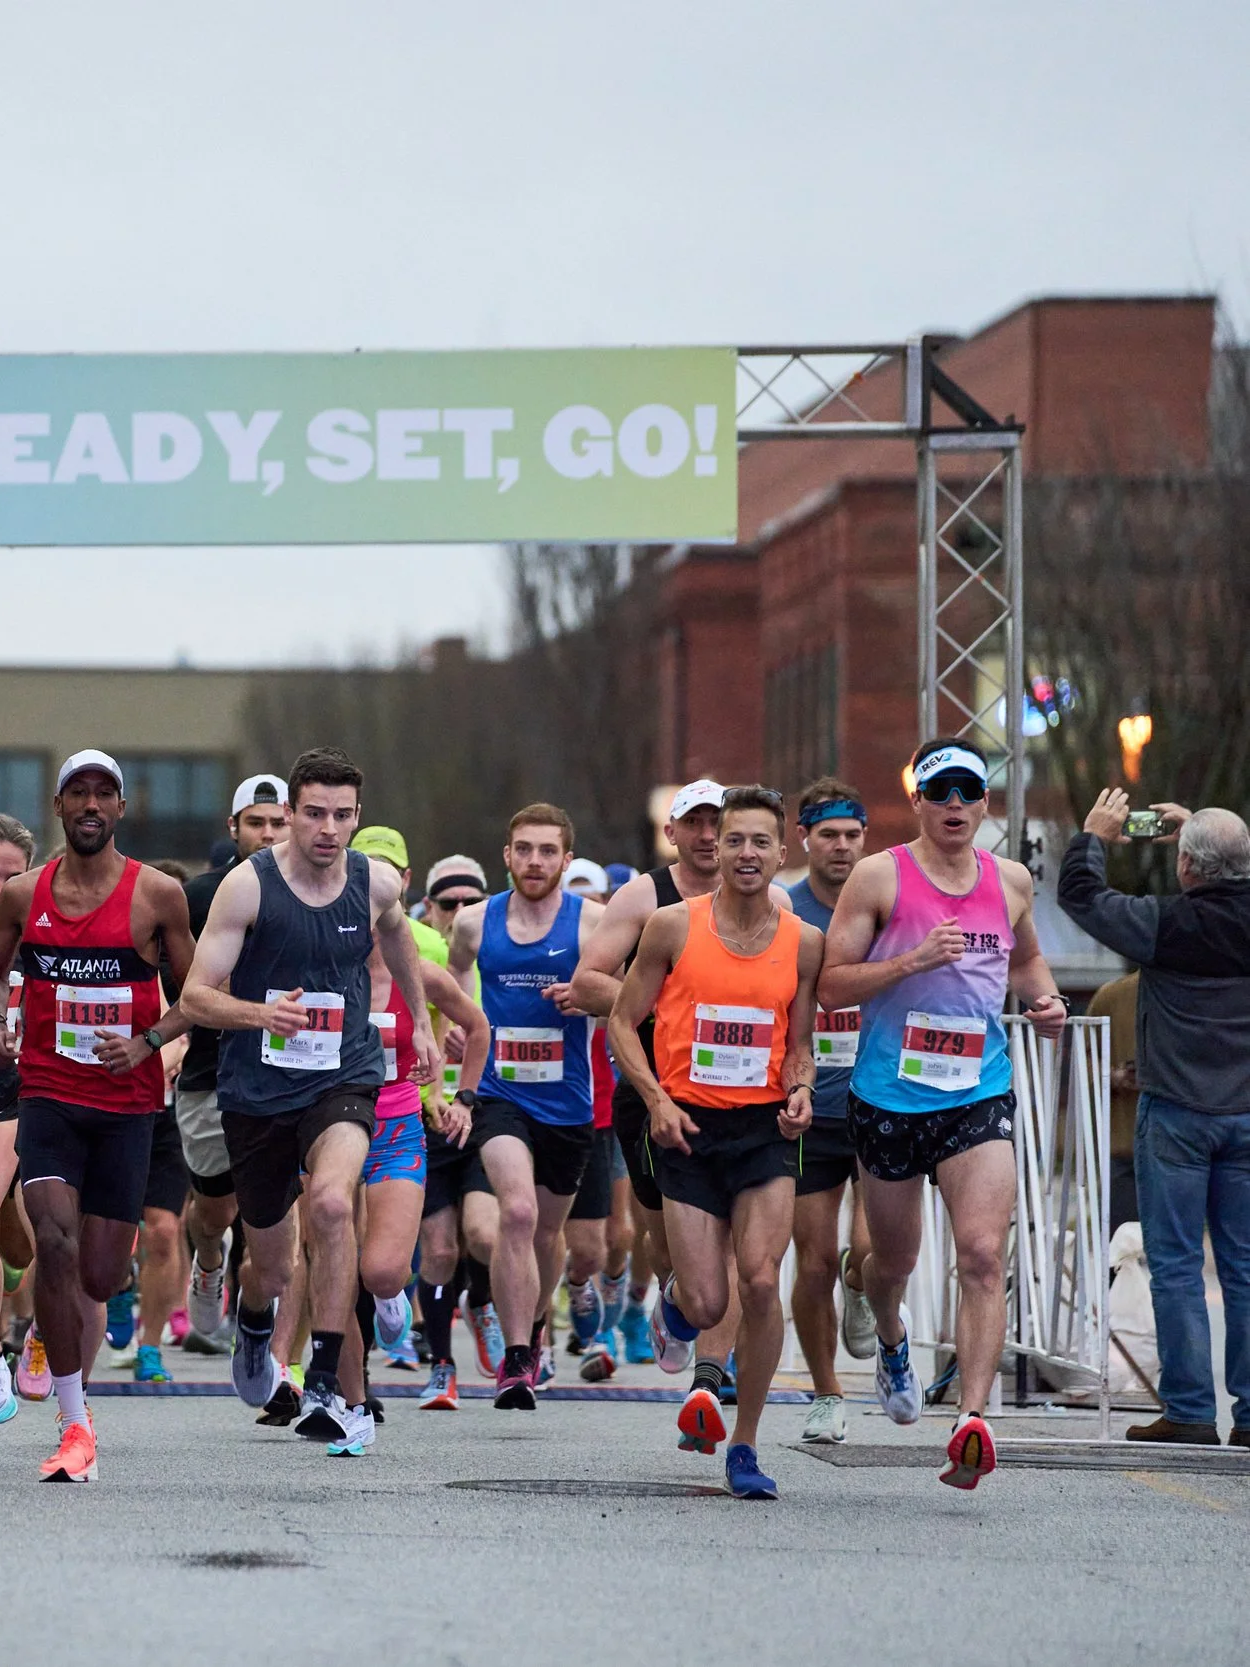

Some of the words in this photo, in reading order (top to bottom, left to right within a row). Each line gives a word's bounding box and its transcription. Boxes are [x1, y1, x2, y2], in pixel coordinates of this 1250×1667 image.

[305, 407, 521, 494] SET,
[542, 403, 718, 480] GO!
[979, 933, 1000, 949] 132
[60, 958, 121, 972] ATLANTA
[69, 1003, 120, 1025] 1193
[305, 1008, 330, 1030] 01
[289, 1038, 309, 1046] Mark
[713, 1021, 754, 1045] 888
[923, 1030, 965, 1055] 979
[507, 1041, 553, 1061] 1065
